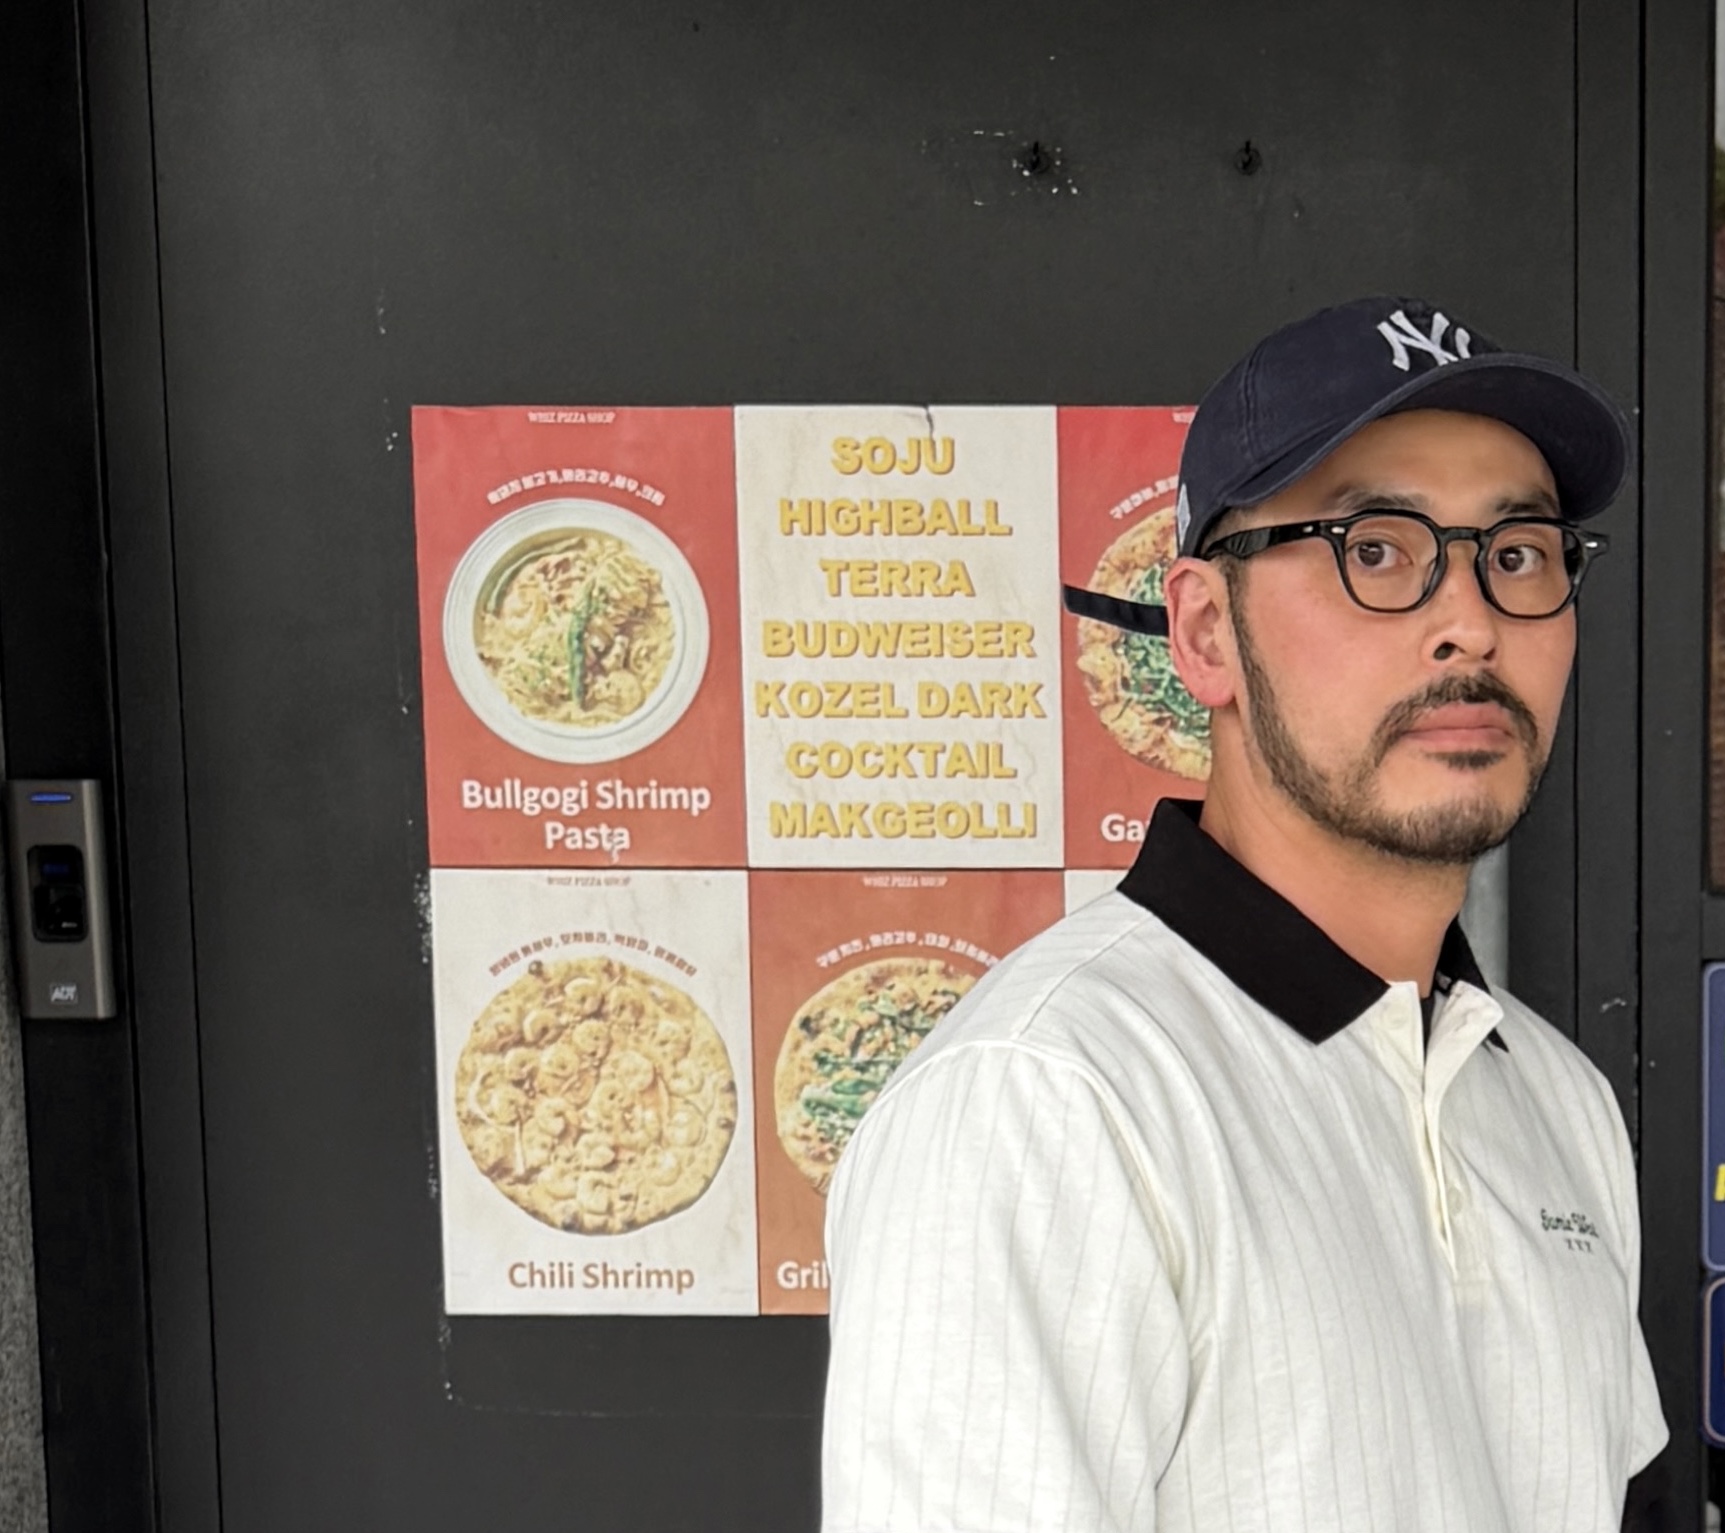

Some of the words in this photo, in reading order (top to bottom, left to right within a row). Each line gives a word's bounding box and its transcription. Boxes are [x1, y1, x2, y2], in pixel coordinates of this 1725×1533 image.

[831, 436, 955, 475] SOJU
[779, 498, 1013, 537] HIGHBALL
[819, 558, 977, 598] TERRA
[762, 620, 1037, 659] BUDWEISER
[754, 680, 909, 718] KOZEL
[917, 680, 1047, 718] DARK
[785, 741, 1018, 779] COCKTAIL
[462, 778, 589, 816] Bullgogi
[595, 780, 711, 817] Shrimp
[544, 821, 632, 850] Pasta
[769, 801, 1038, 839] MAKGEOLLI
[1101, 813, 1149, 842] Ga
[508, 1261, 575, 1290] Chili
[582, 1261, 695, 1294] Shrimp
[777, 1260, 829, 1290] Gril
